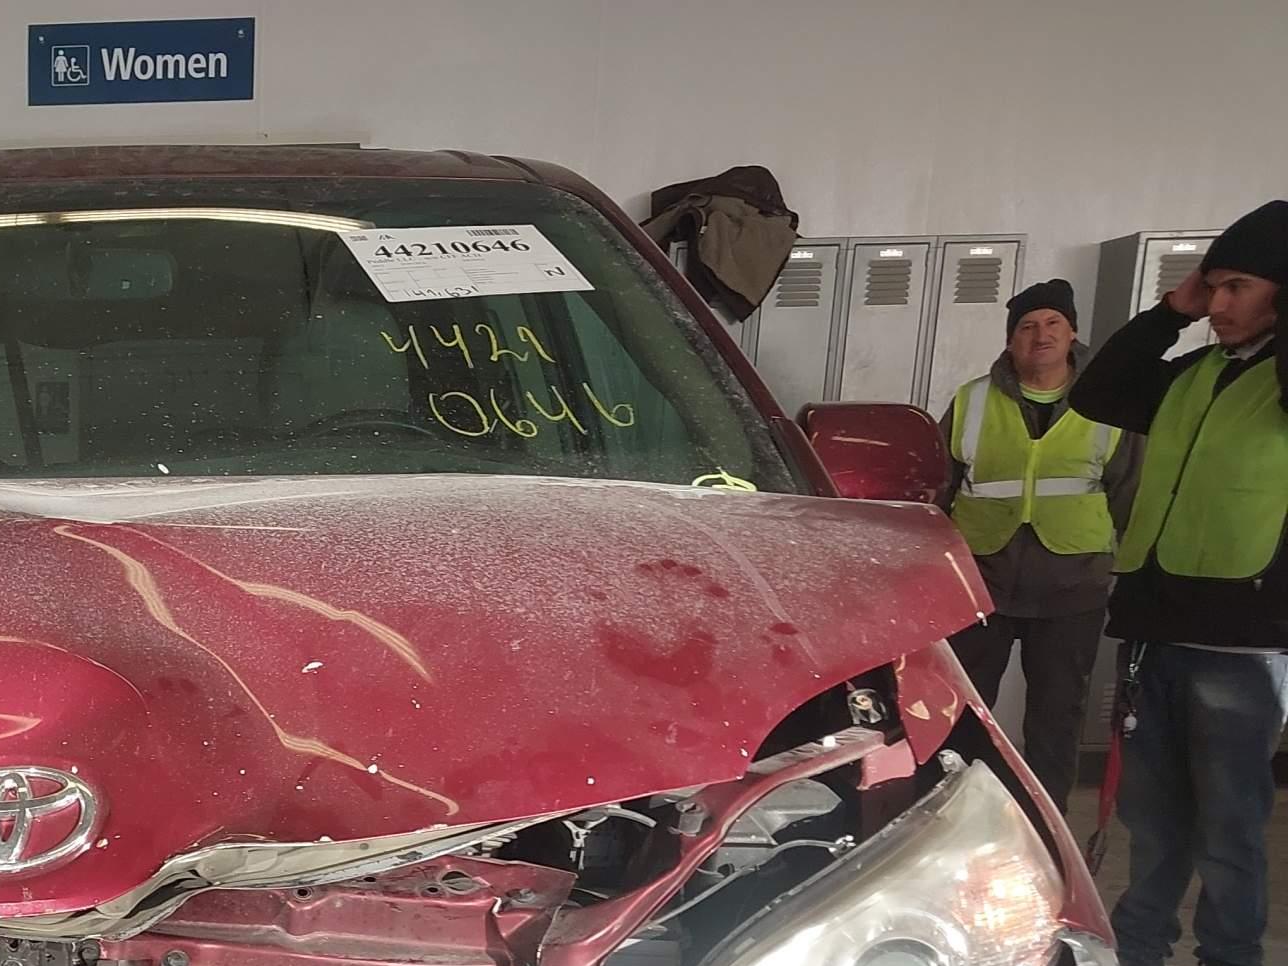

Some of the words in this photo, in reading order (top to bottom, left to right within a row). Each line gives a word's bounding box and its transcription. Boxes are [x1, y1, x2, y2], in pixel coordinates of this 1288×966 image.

[101, 47, 228, 81] Women
[374, 238, 531, 258] 44210646
[428, 382, 635, 438] 0646
